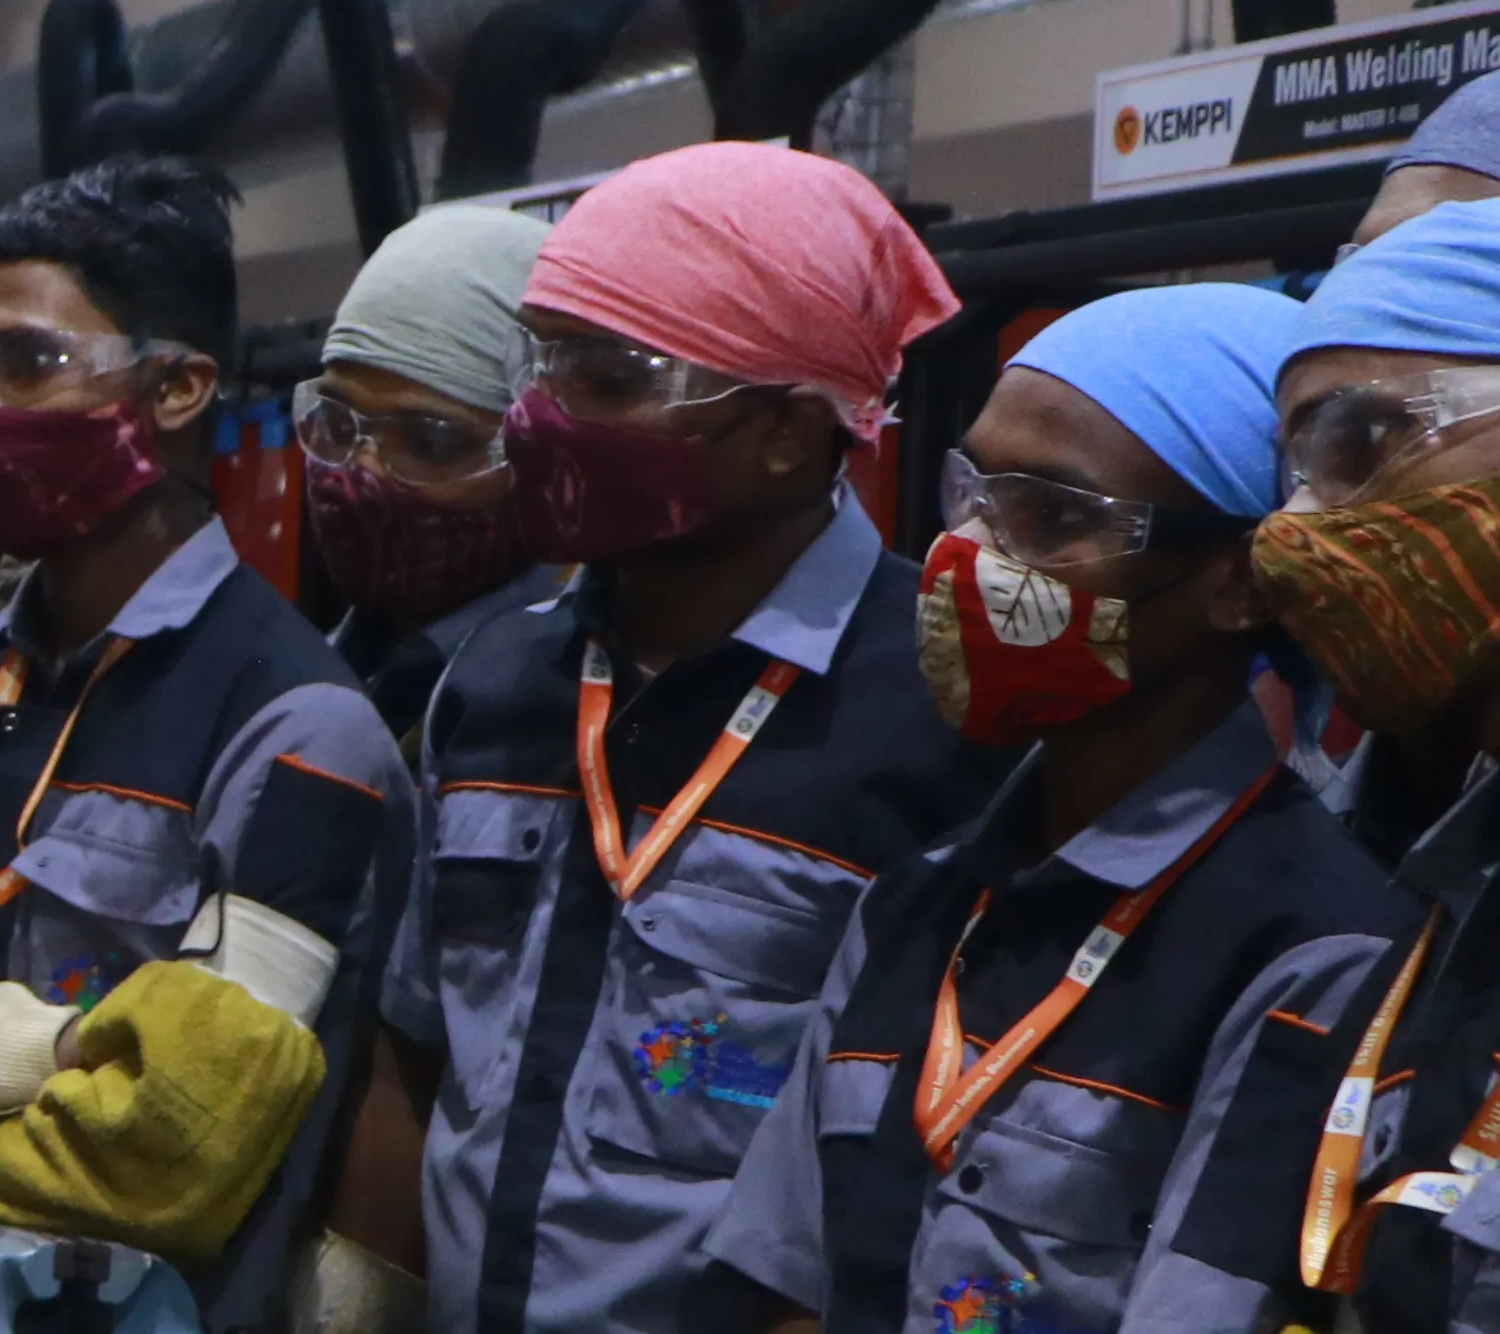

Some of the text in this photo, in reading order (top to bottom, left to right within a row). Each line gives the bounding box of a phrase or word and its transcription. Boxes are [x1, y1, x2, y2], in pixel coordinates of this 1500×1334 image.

[1273, 55, 1338, 106] MMA
[1345, 42, 1454, 94] Welding
[1143, 97, 1233, 146] KEMPPI
